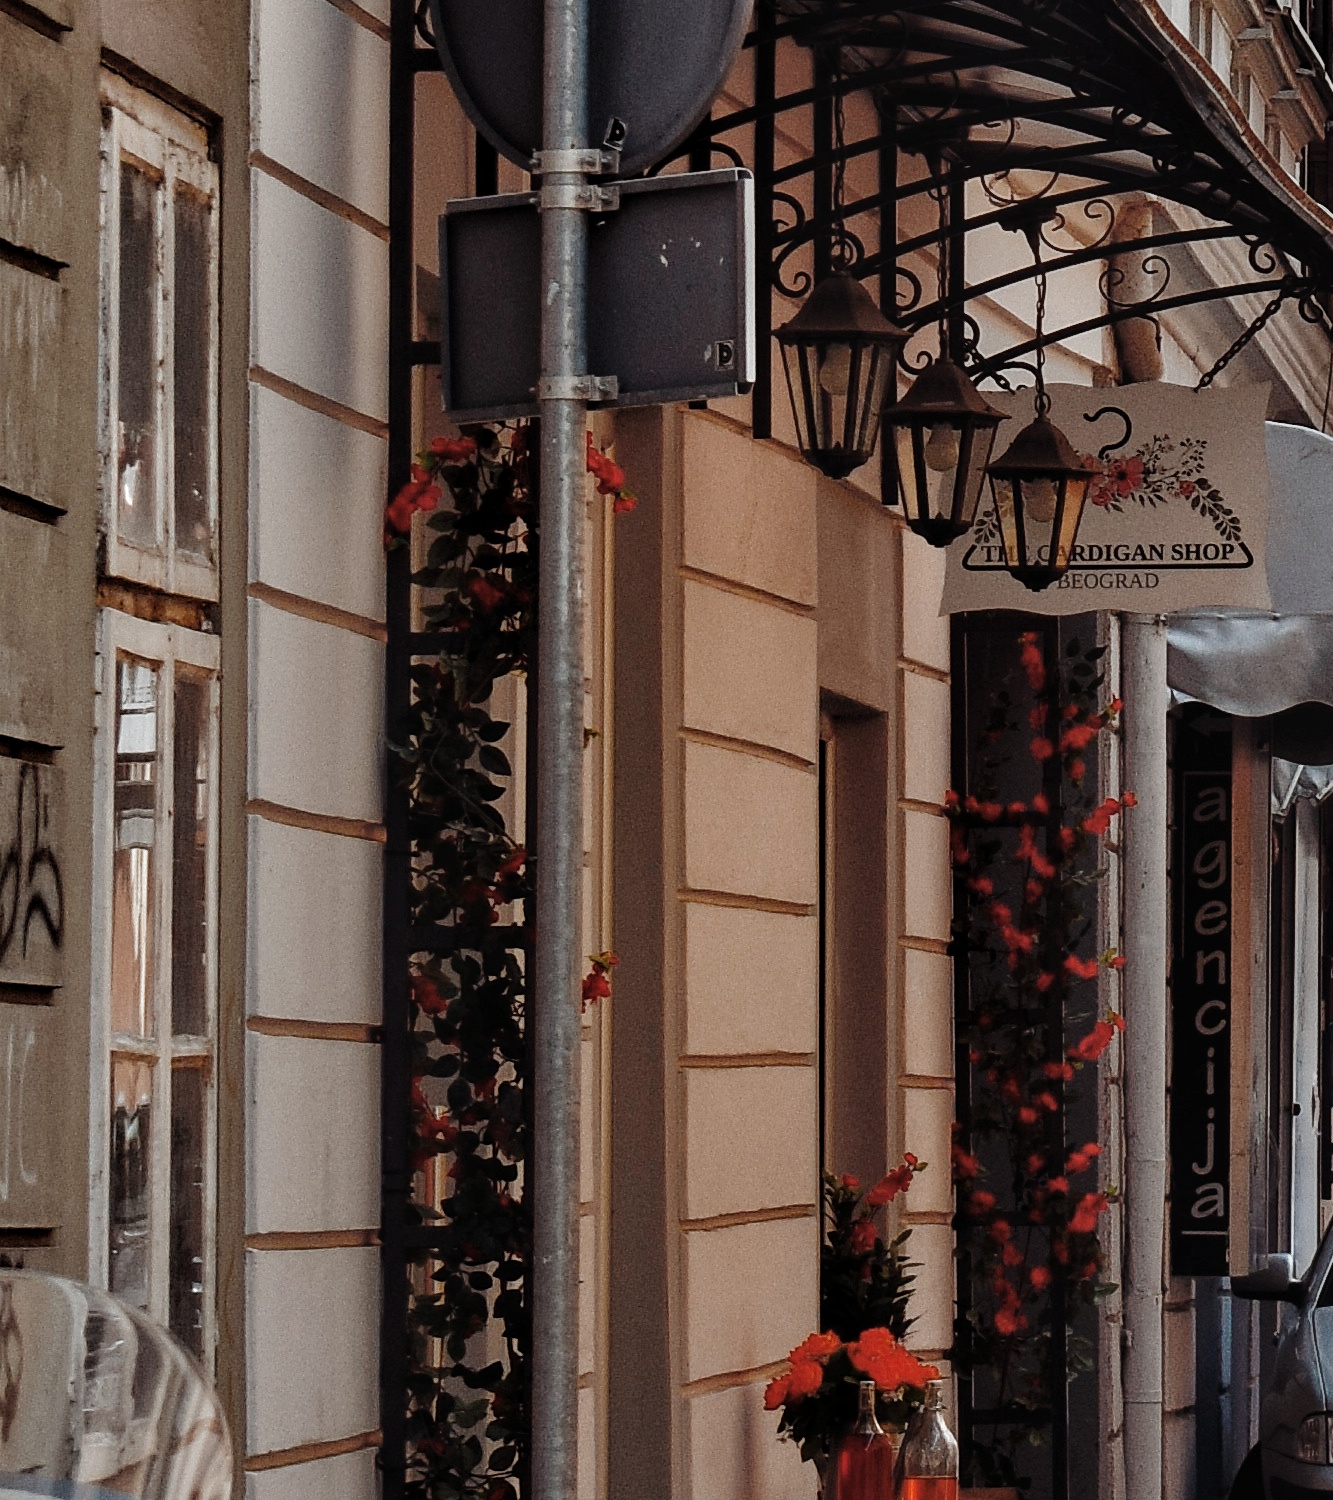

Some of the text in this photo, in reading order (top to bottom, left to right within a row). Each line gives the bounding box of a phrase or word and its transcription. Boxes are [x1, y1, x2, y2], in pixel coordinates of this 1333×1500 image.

[981, 545, 1030, 563] TH
[1171, 543, 1235, 562] SHOP
[1057, 572, 1160, 590] BEOGRAD
